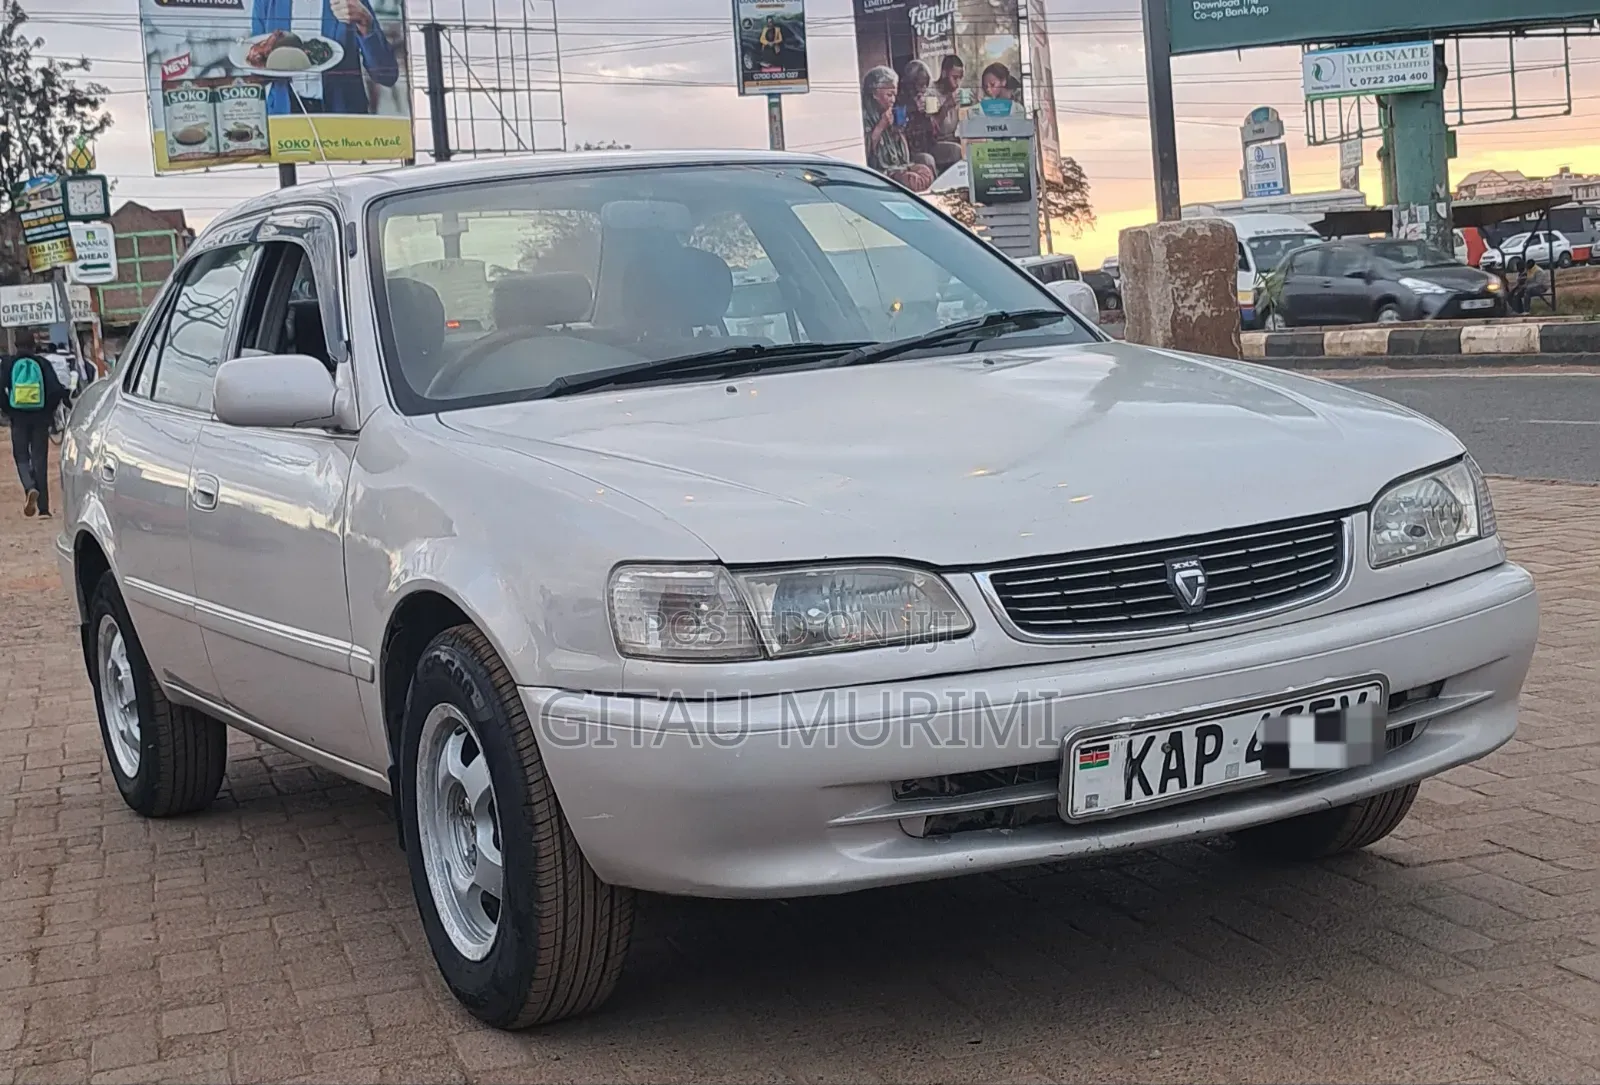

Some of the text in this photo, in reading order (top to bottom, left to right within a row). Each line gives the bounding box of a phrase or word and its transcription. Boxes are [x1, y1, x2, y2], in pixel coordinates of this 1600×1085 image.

[1193, 0, 1240, 10] Download
[1193, 5, 1269, 20] Co-op Bank App
[1347, 46, 1430, 66] MAGNATE
[163, 56, 190, 76] NEW
[1346, 60, 1430, 74] VENTURES LIMITED
[1360, 71, 1429, 86] 0722 204 400
[169, 89, 207, 102] SOKO
[221, 86, 258, 99] SOKO
[986, 124, 1009, 132] THIKA
[277, 138, 311, 150] SOKO
[341, 136, 363, 148] than
[364, 139, 372, 147] a
[373, 134, 402, 147] Meal
[78, 252, 108, 260] AHEAD
[2, 301, 53, 314] GRETSA
[3, 311, 53, 323] UNIVERSITY
[1124, 724, 1224, 800] KAP
